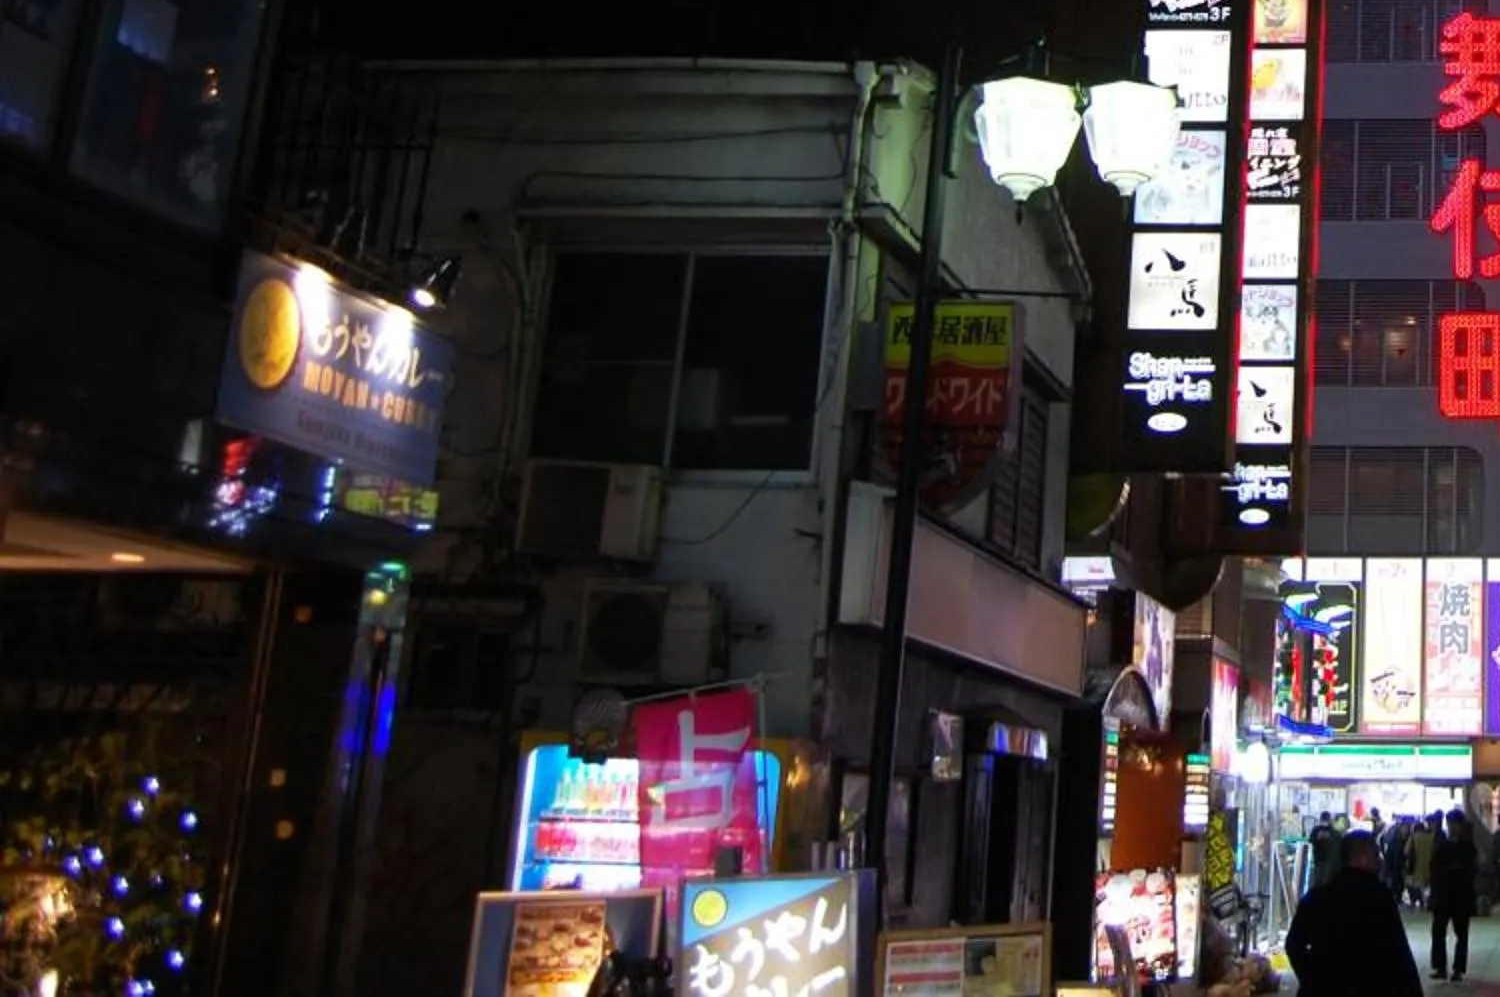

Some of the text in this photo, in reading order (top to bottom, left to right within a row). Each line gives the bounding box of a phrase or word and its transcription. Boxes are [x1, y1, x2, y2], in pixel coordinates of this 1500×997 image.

[1209, 7, 1231, 21] 3F
[892, 314, 1008, 348] 西居酒屋
[1438, 581, 1472, 655] 焼肉
[690, 896, 847, 997] もうやん
